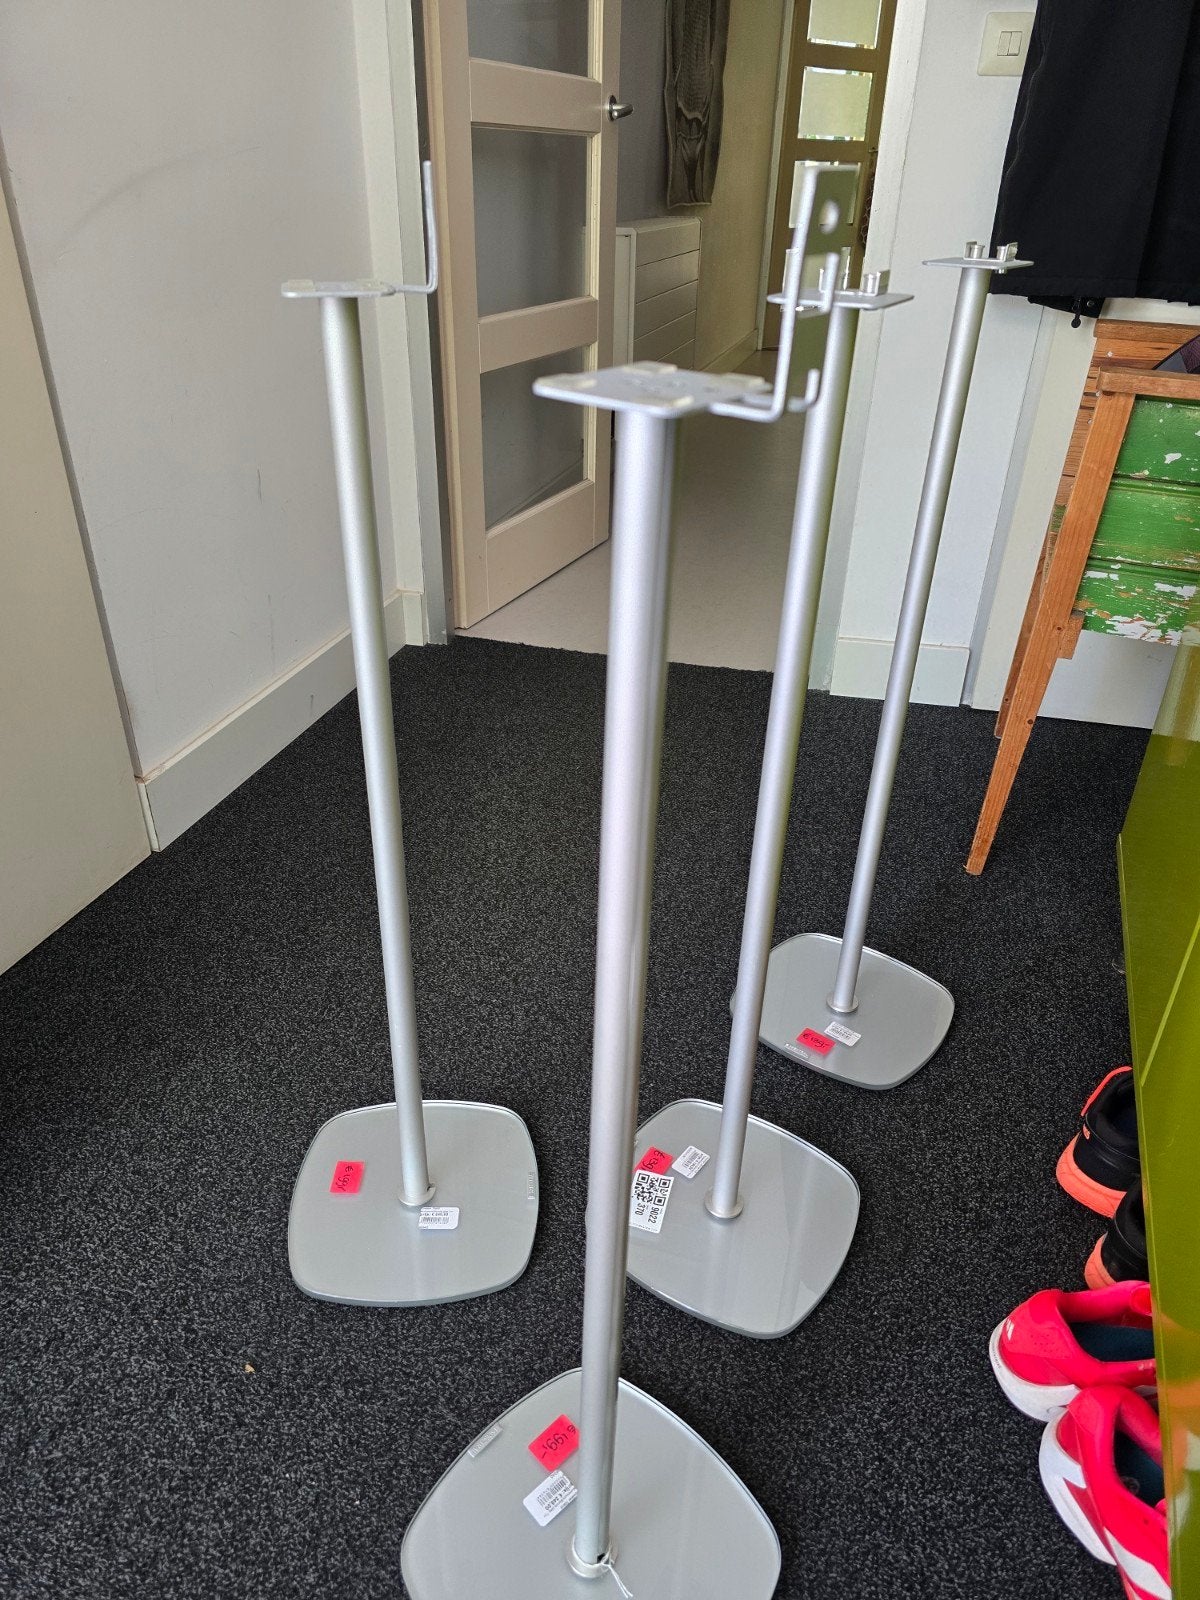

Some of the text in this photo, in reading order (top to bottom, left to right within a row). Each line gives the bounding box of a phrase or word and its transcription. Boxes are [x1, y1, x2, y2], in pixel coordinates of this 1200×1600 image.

[635, 1203, 646, 1216] 370
[648, 1207, 660, 1224] 9022
[567, 1424, 577, 1434] €
